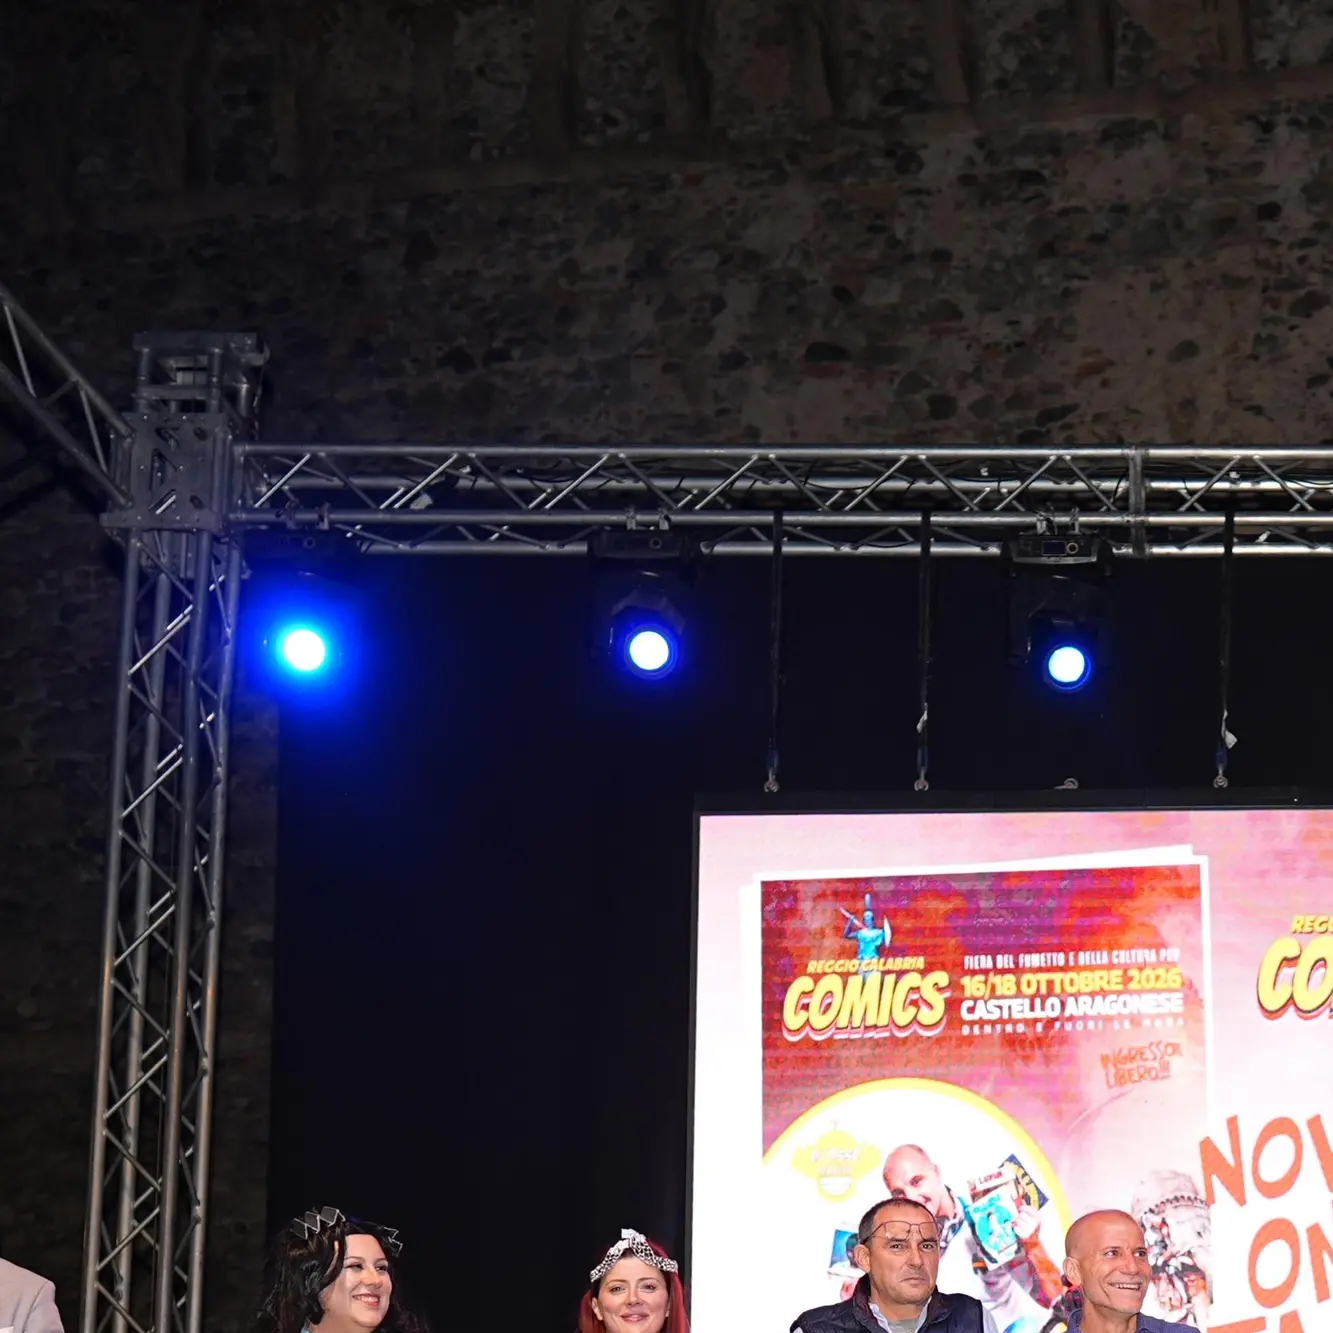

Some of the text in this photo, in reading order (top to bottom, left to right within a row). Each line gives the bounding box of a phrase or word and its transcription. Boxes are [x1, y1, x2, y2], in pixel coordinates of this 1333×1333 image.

[806, 956, 926, 974] REGGIO CALABRIA
[1018, 951, 1065, 969] FUMETTO
[1069, 951, 1075, 967] E
[1078, 949, 1109, 967] DELLA
[1111, 948, 1157, 965] CULTURA
[960, 967, 1183, 1000] 16/18 OTTOBRE 2026
[783, 970, 951, 1037] COMICS
[960, 992, 1184, 1021] CASTELLO ARAGONESE
